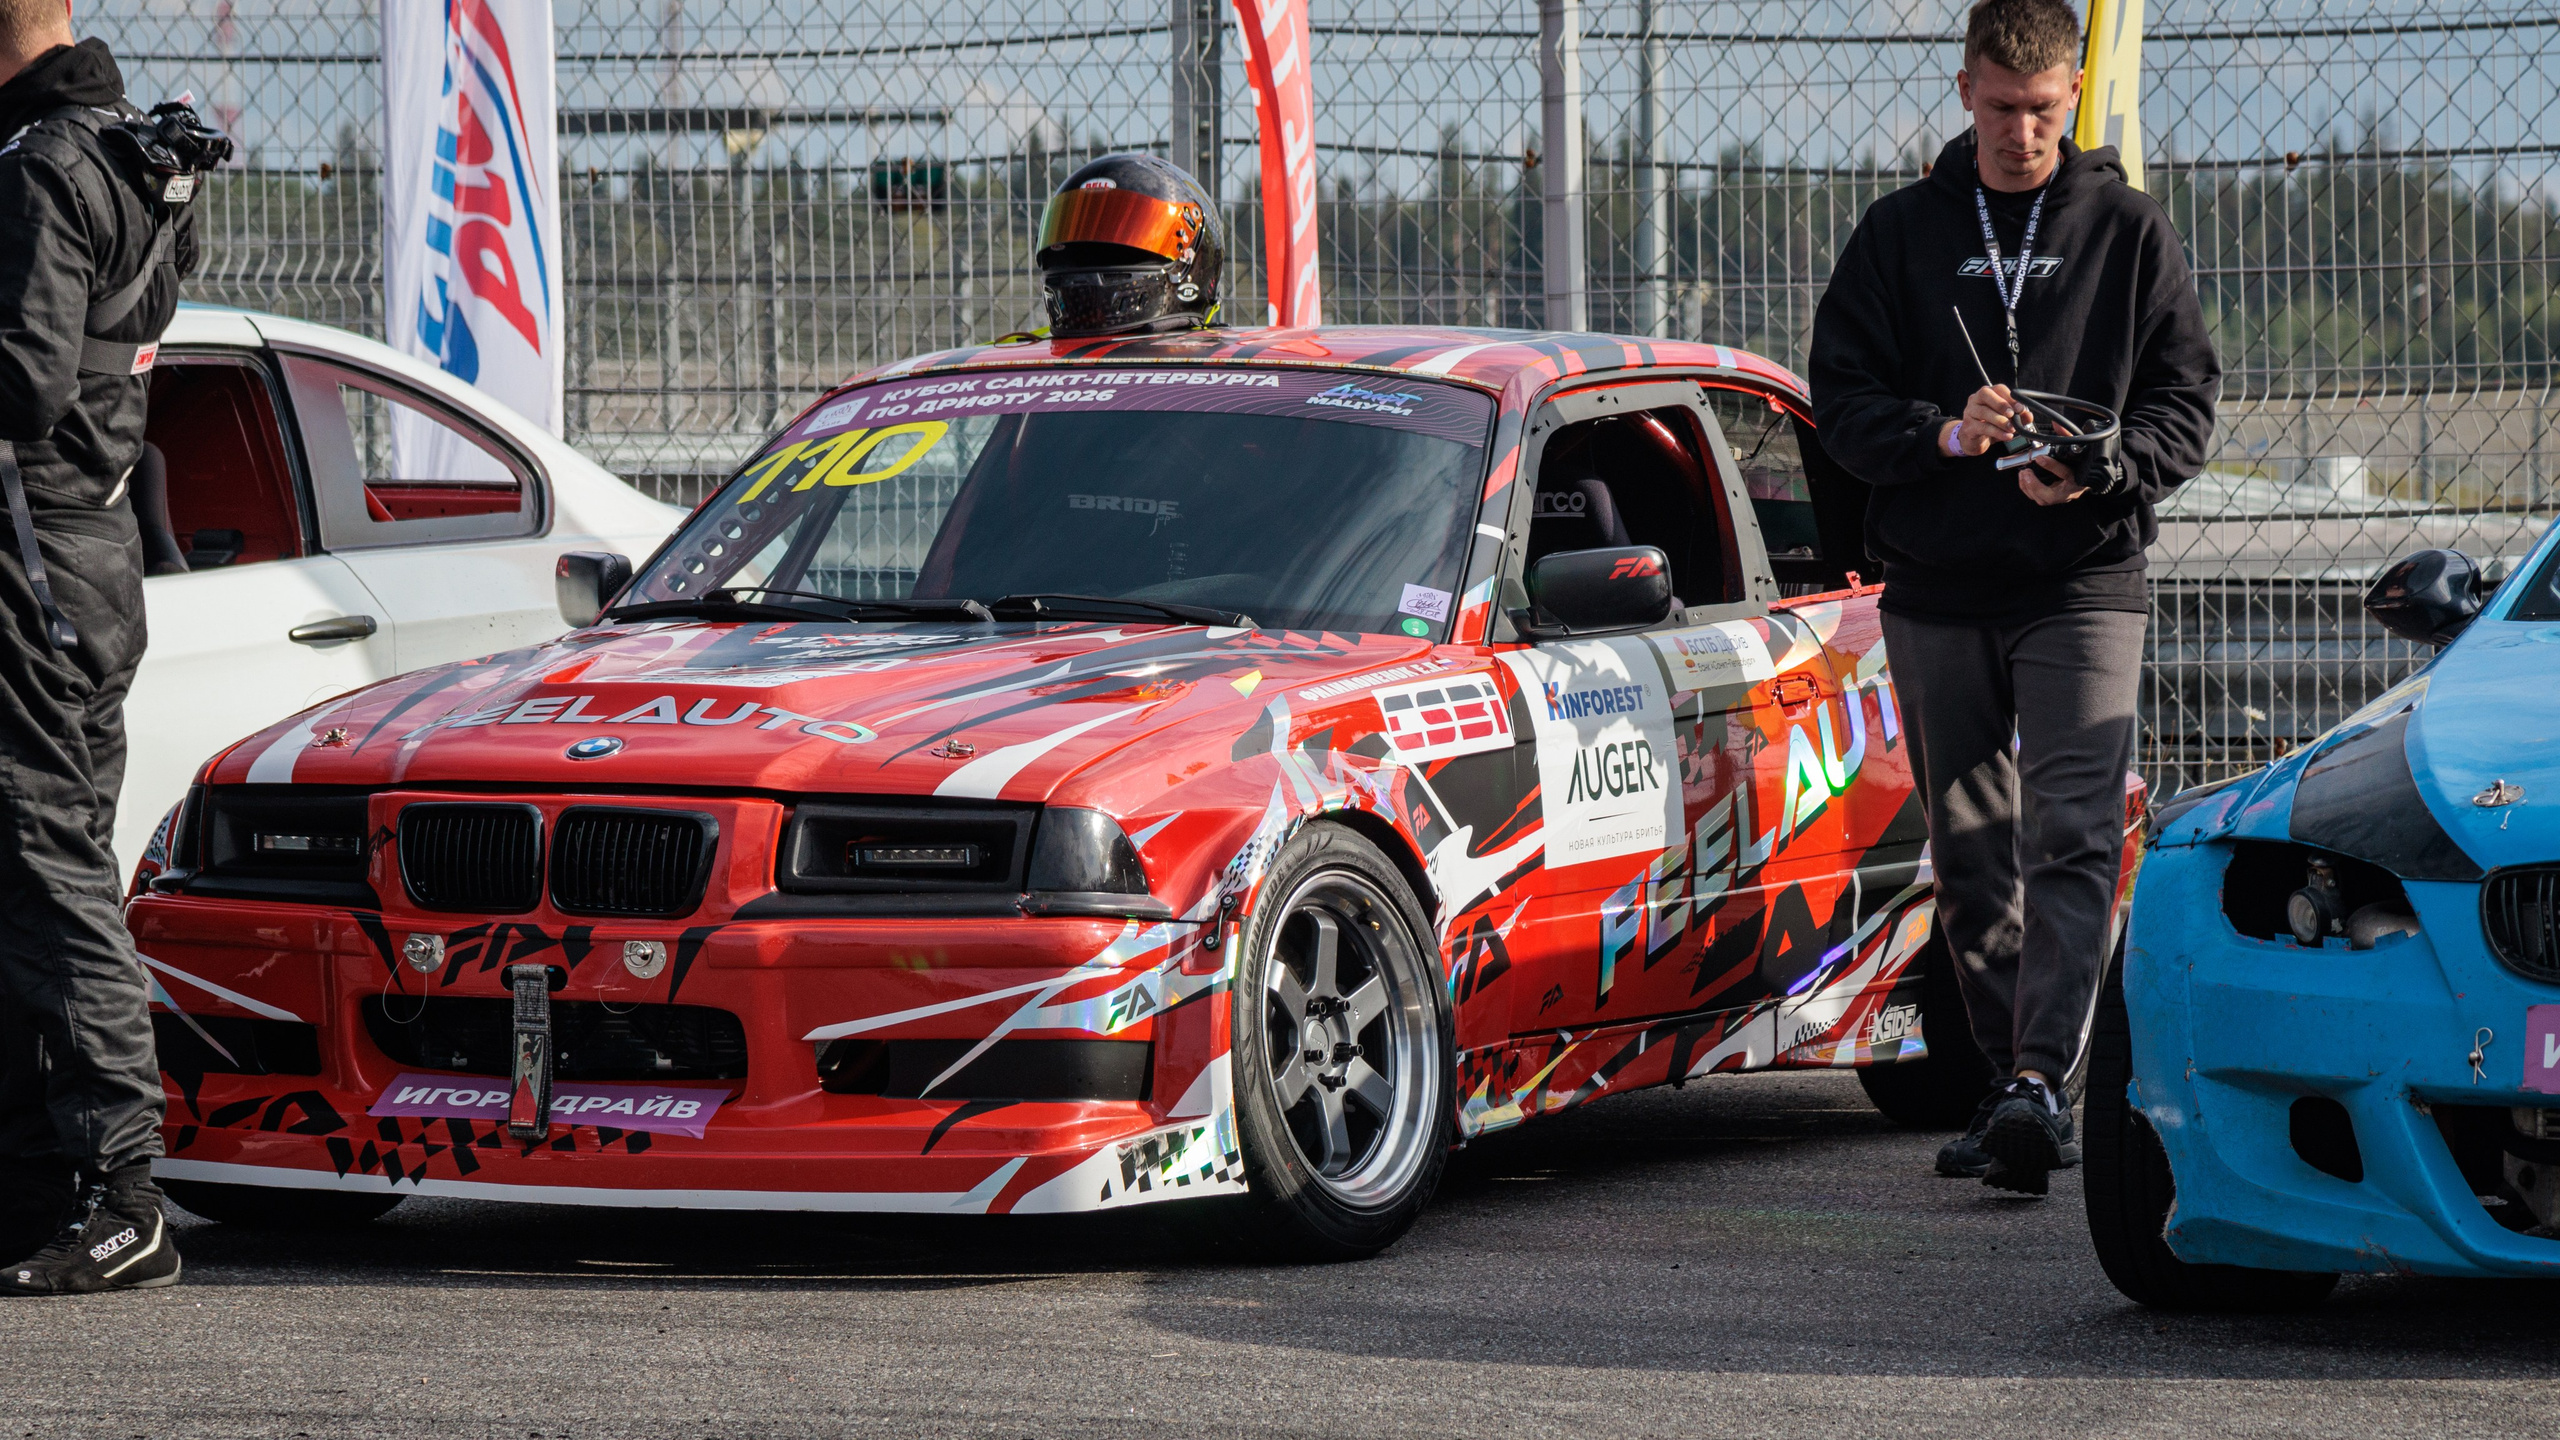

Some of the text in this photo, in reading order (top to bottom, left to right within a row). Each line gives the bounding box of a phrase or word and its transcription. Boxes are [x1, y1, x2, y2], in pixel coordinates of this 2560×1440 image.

[2010, 249, 2032, 310] РАДИОСИЛА
[866, 389, 1118, 421] ПО ДРИФТУ 2026
[879, 373, 1280, 404] КУБОК САНКТ-ПЕТЕРБУРГА
[1305, 396, 1414, 416] МАЦУРИ
[738, 420, 949, 505] 110
[1067, 494, 1180, 516] BRIDE
[1686, 637, 1718, 656] БСПБ
[1542, 682, 1644, 721] KINFOREST
[397, 695, 879, 745] FEELAUTO
[1567, 740, 1660, 804] AUGER
[1568, 824, 1664, 851] НОВАЯ КУЛЬТУРА БРИТЬЯ
[1105, 982, 1157, 1032] FA
[392, 1086, 702, 1120] ИГОР ДРАЙВ
[90, 1227, 137, 1260] sparco
